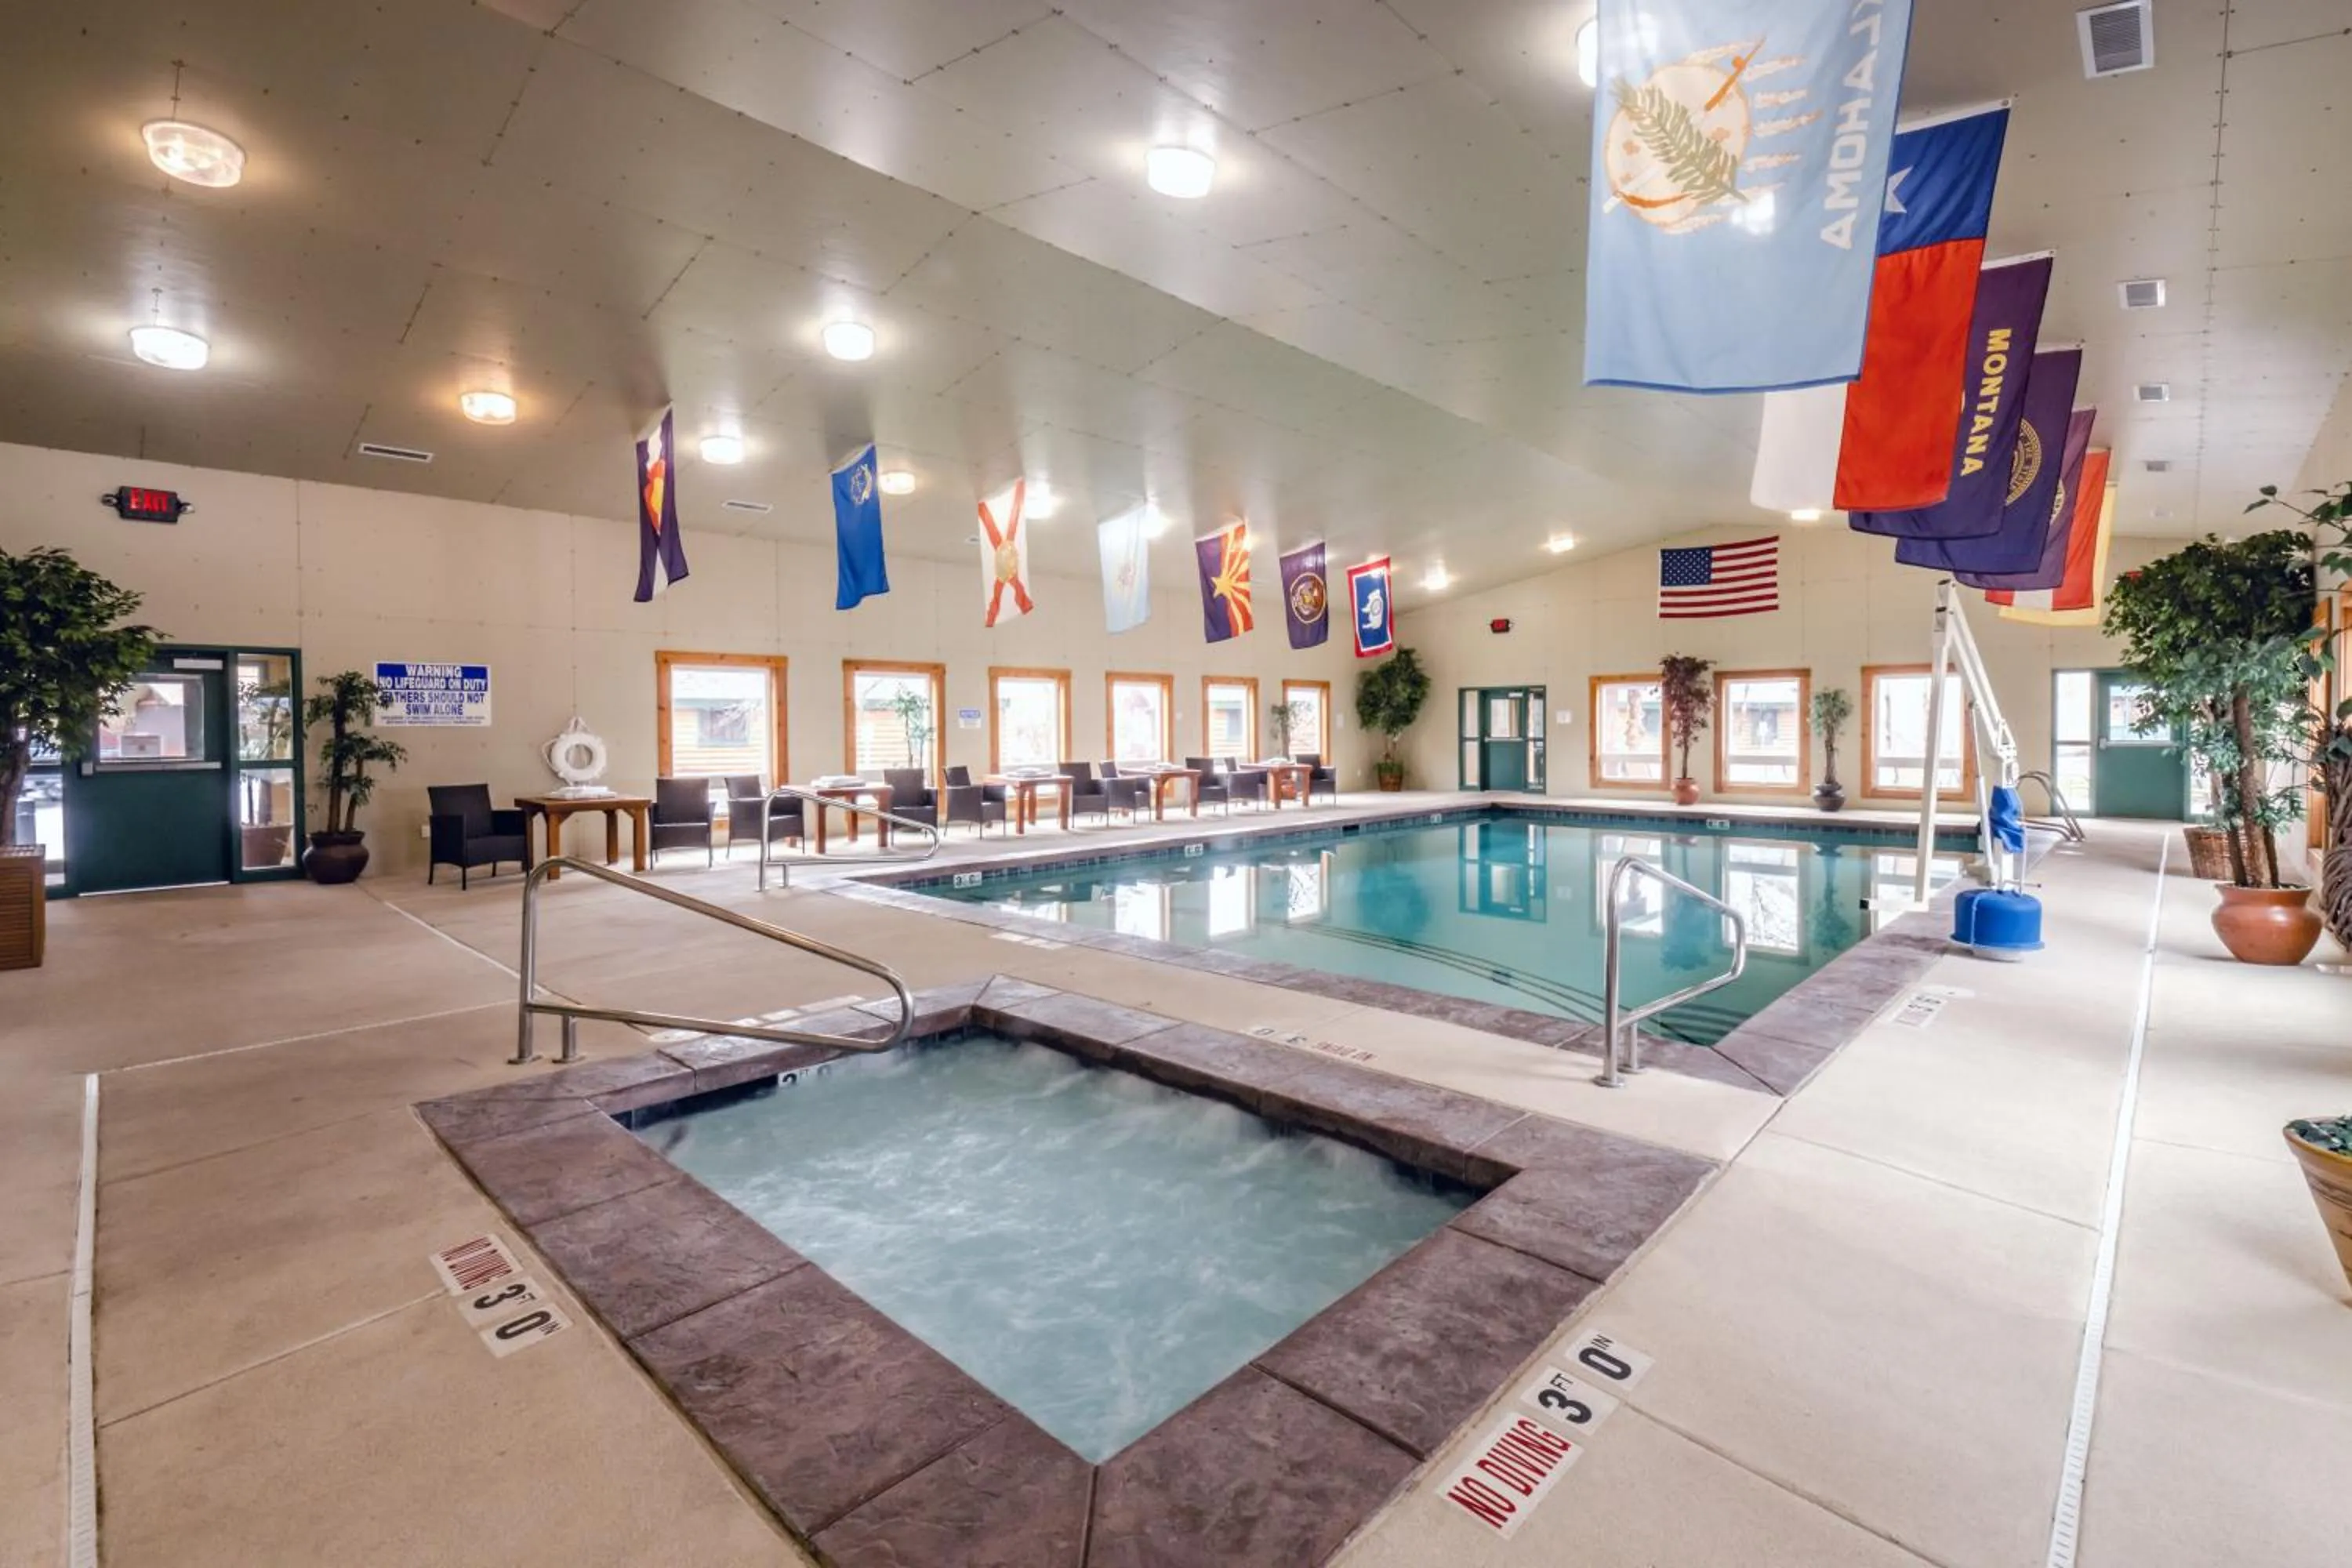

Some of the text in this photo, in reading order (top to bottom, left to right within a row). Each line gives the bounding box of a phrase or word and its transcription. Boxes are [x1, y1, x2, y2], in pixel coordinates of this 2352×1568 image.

[1961, 328, 2012, 477] MONTANA
[130, 488, 169, 513] EXIT
[405, 664, 463, 678] WARNING
[394, 677, 446, 690] LIFEGUARD
[448, 678, 462, 690] ON
[463, 678, 487, 691] DUTY
[405, 703, 463, 715] SWIM ALONE
[427, 691, 465, 704] SHOULD
[466, 692, 485, 703] NOT
[474, 1283, 526, 1308] 3
[495, 1310, 552, 1340] 0
[1578, 1346, 1632, 1381] 0
[1549, 1373, 1573, 1392] FT
[1537, 1388, 1592, 1425] 3
[1447, 1419, 1572, 1529] NO DIVING
